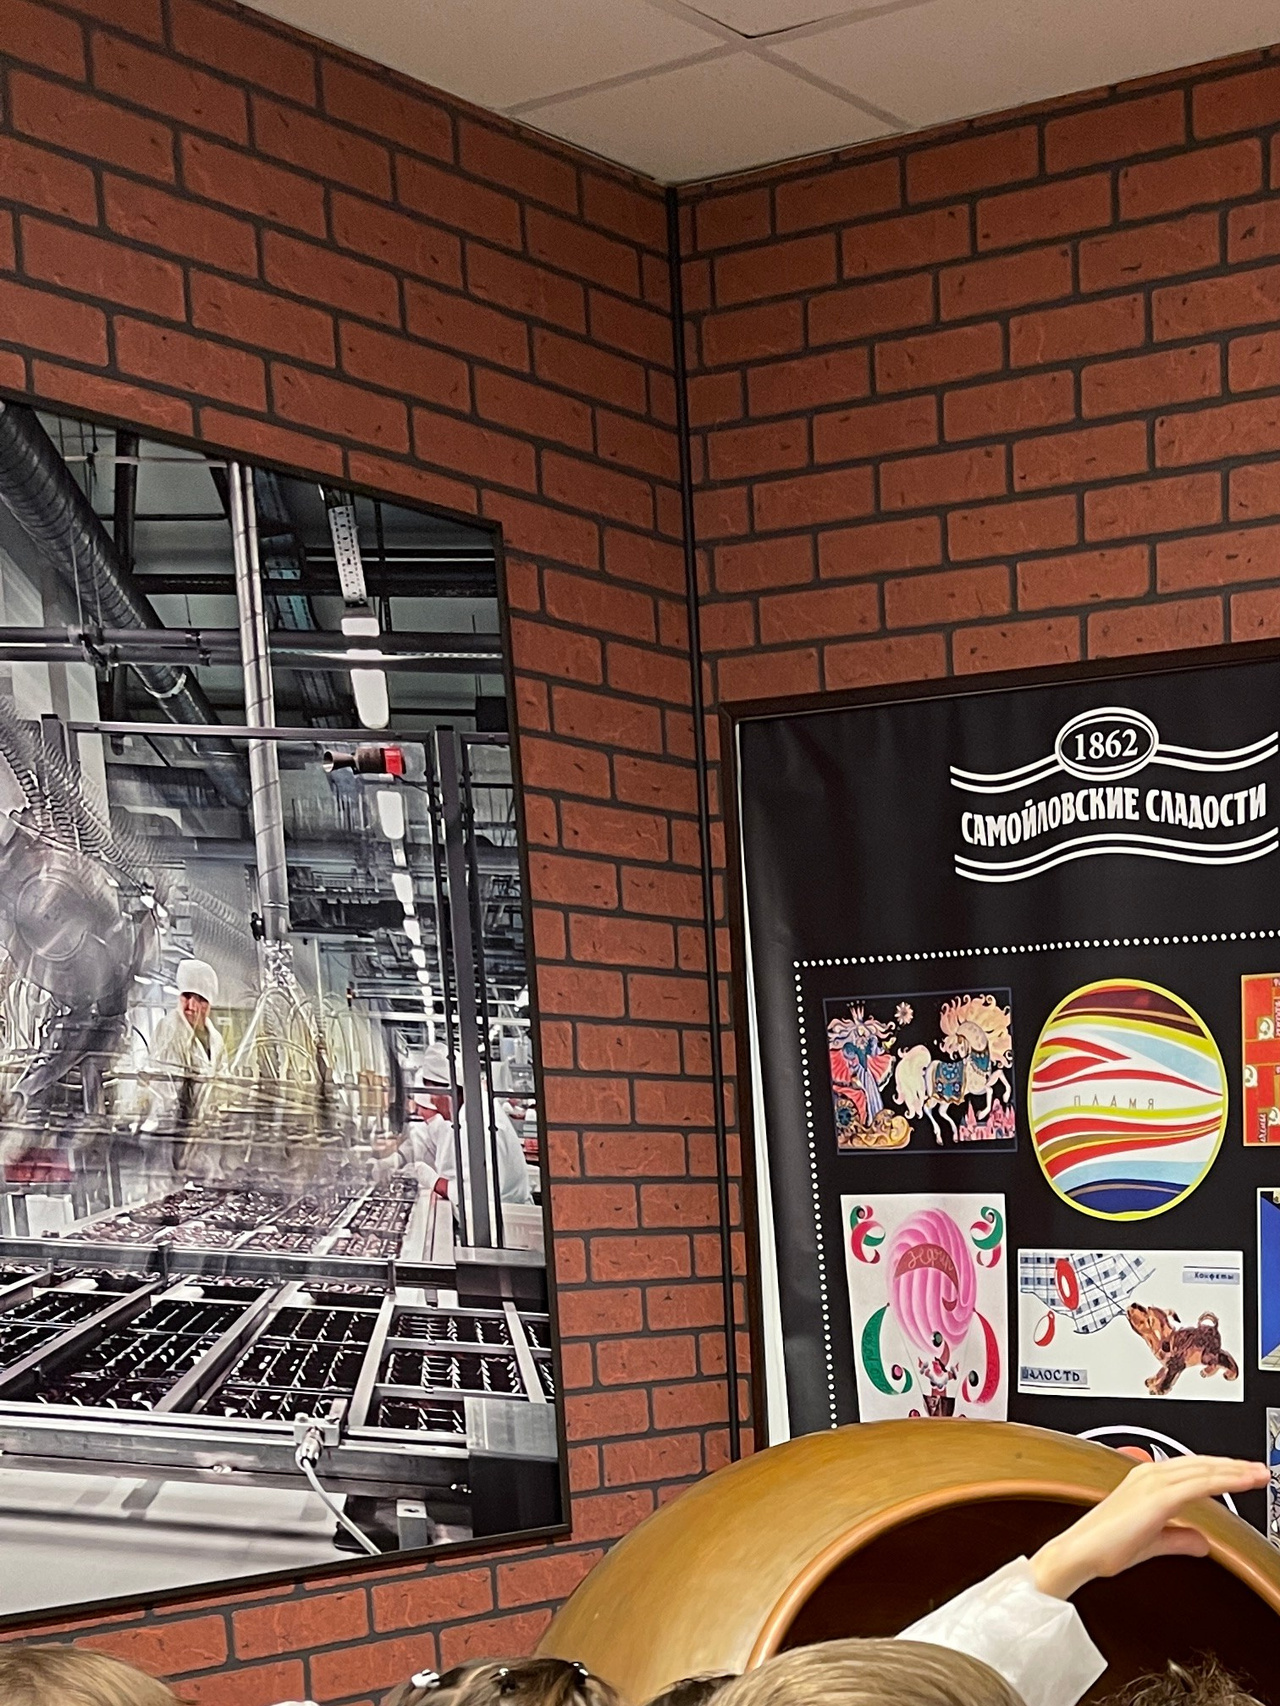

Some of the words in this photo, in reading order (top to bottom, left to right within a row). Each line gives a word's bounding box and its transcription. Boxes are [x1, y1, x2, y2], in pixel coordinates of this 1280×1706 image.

[1074, 728, 1139, 761] 1862
[961, 786, 1140, 847] САМОЙЛОВСКИЕ
[1145, 782, 1267, 830] СЛАДОСТИ
[1073, 1093, 1155, 1111] ПЛАМЯ
